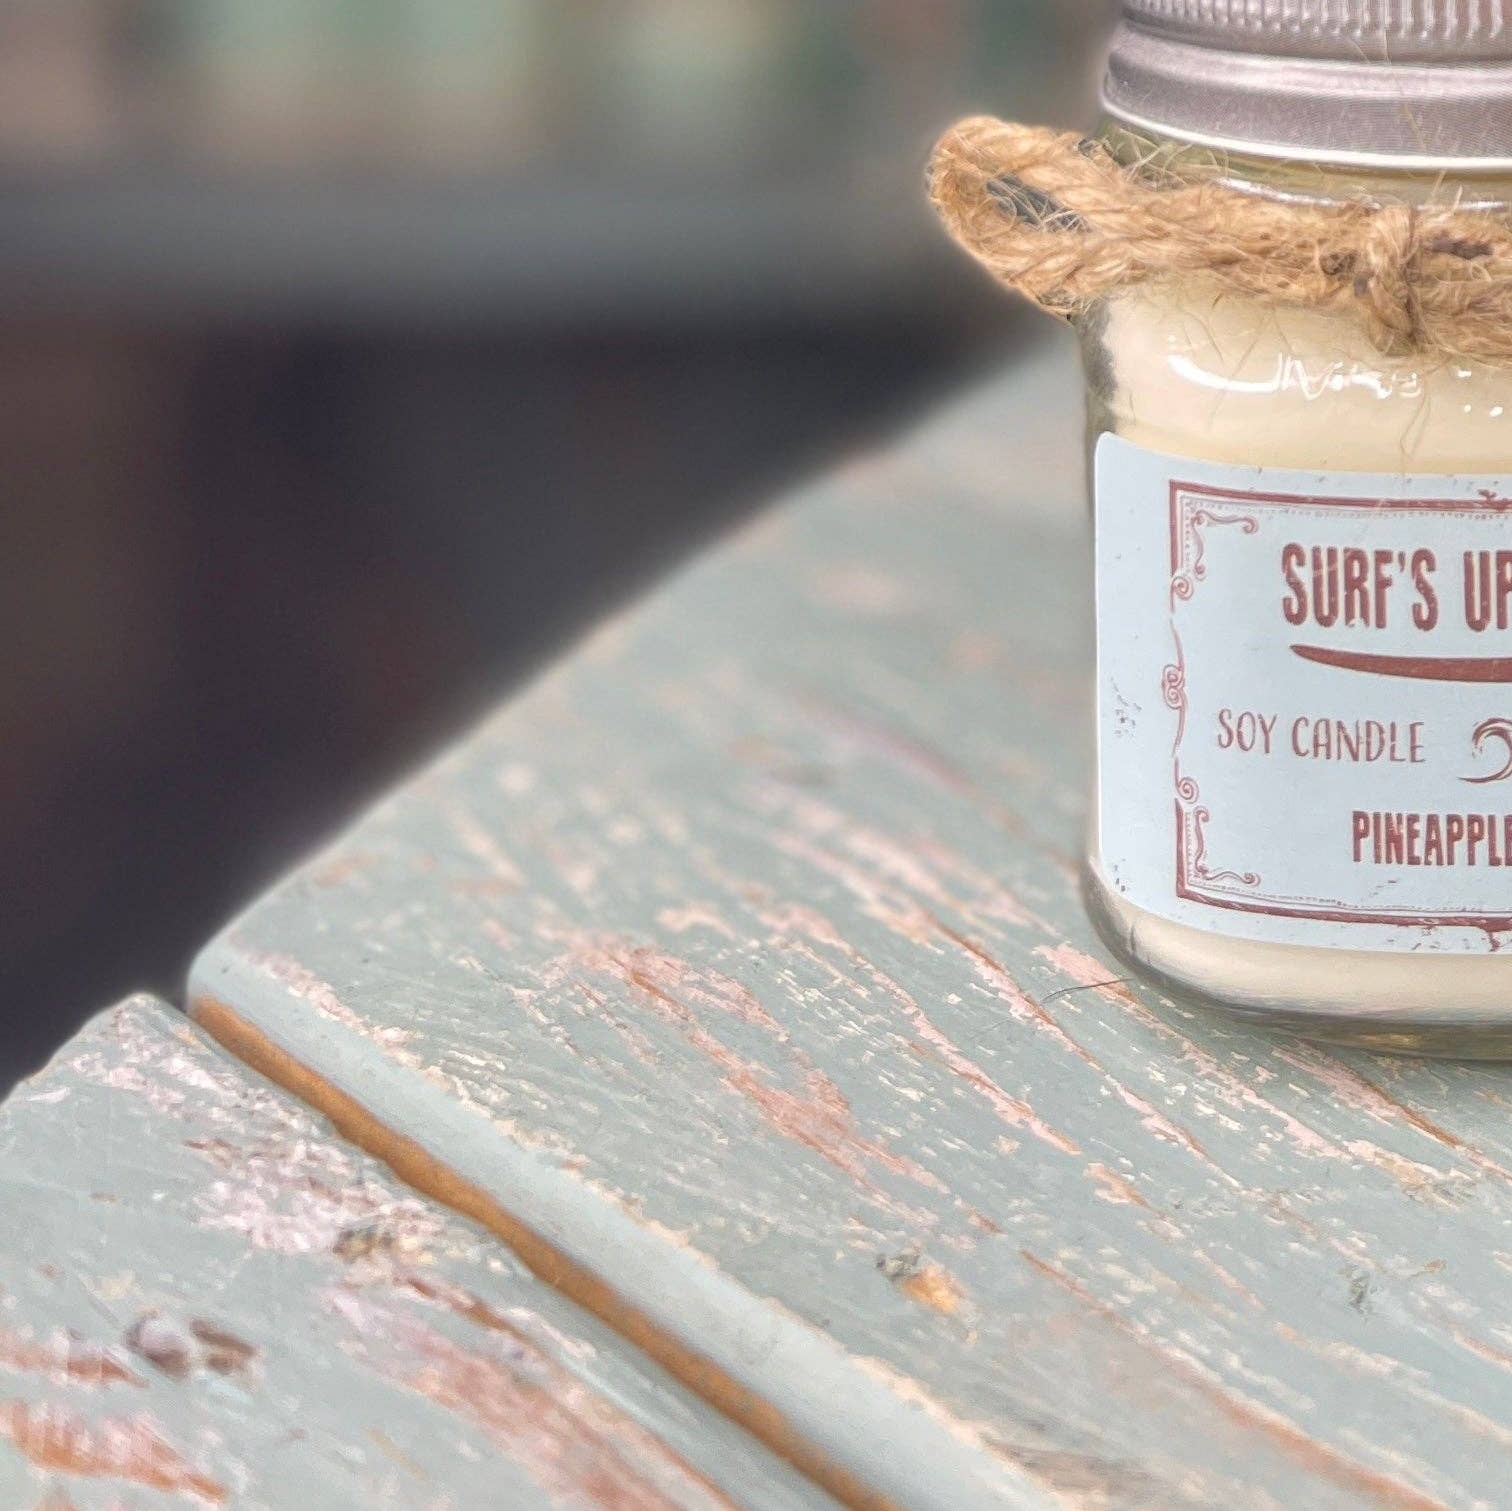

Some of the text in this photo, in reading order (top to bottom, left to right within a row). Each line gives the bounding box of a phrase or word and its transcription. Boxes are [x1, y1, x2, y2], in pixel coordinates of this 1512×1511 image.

[1281, 542, 1439, 632] SURF'S
[1216, 708, 1427, 764] SOY CANDLE
